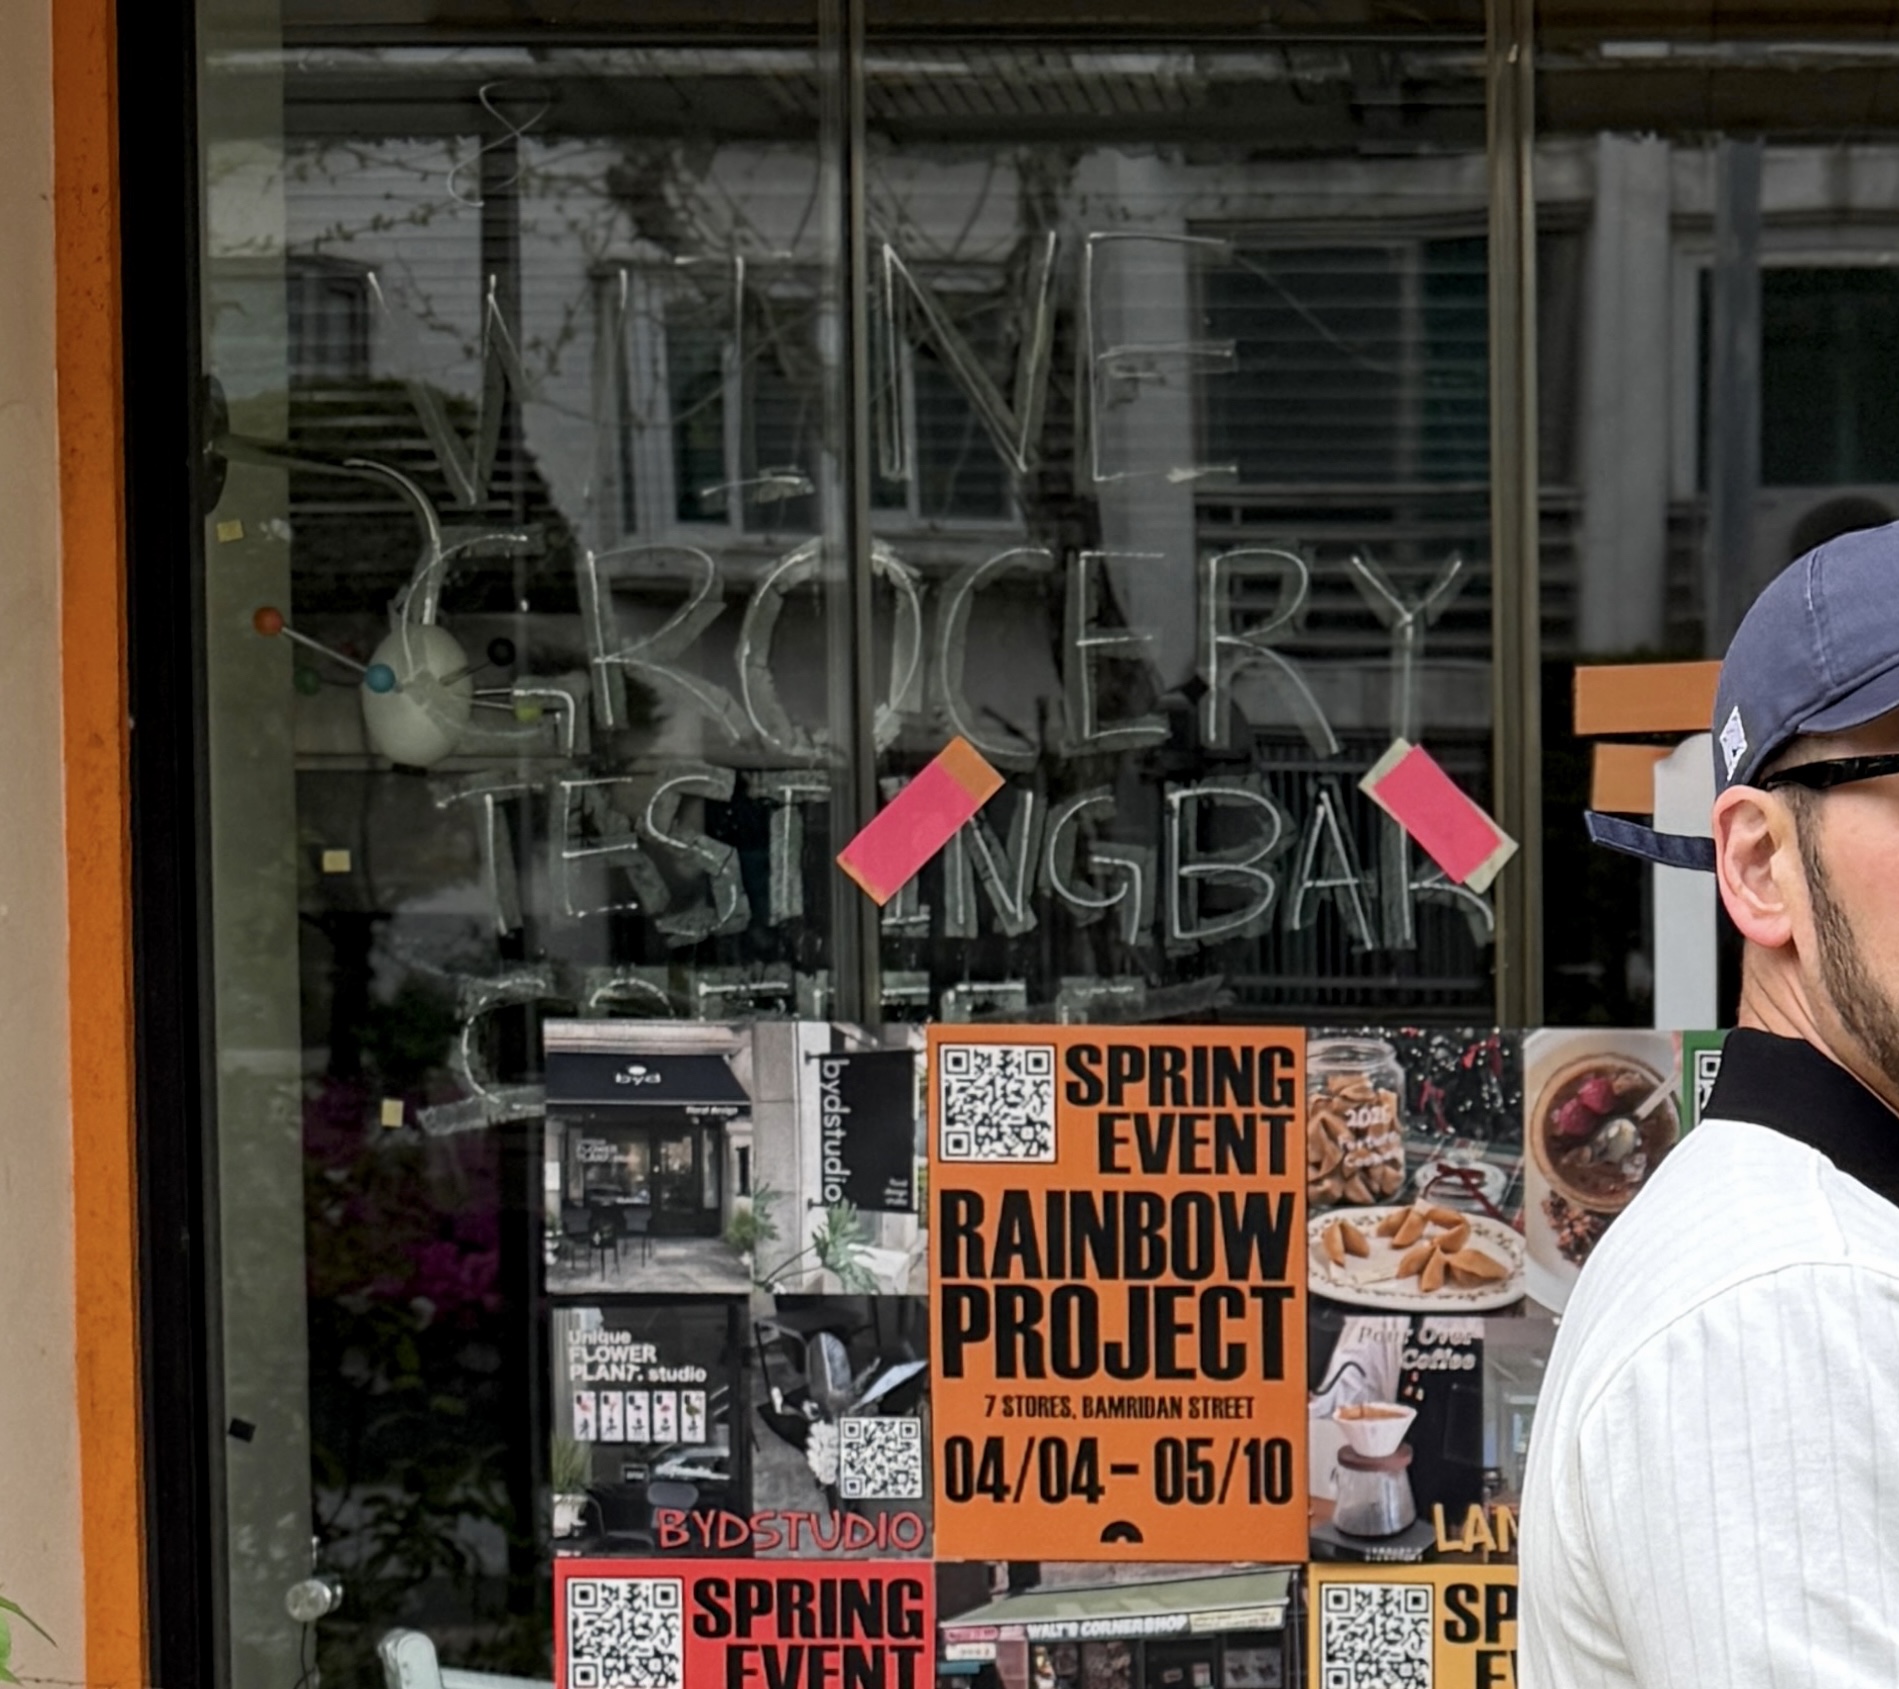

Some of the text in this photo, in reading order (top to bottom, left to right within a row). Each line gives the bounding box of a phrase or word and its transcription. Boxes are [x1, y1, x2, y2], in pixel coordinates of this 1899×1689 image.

[398, 533, 1467, 758] GROCERY
[434, 766, 1498, 954] TESTNGBAR
[1065, 1043, 1295, 1109] SPRING
[820, 1058, 852, 1202] bydstudio
[1097, 1112, 1295, 1176] EVENT
[939, 1189, 1295, 1282] RAINBOW
[569, 1330, 632, 1346] Unique
[569, 1344, 657, 1363] FLOWER
[941, 1283, 1295, 1382] PROJECT
[1401, 1348, 1476, 1370] Coffee
[648, 1365, 707, 1382] studio
[985, 1394, 1254, 1420] 7 STORES, BAMRIDAN STREET
[656, 1508, 925, 1551] BYDSTUDIO
[692, 1577, 924, 1640] SPRING
